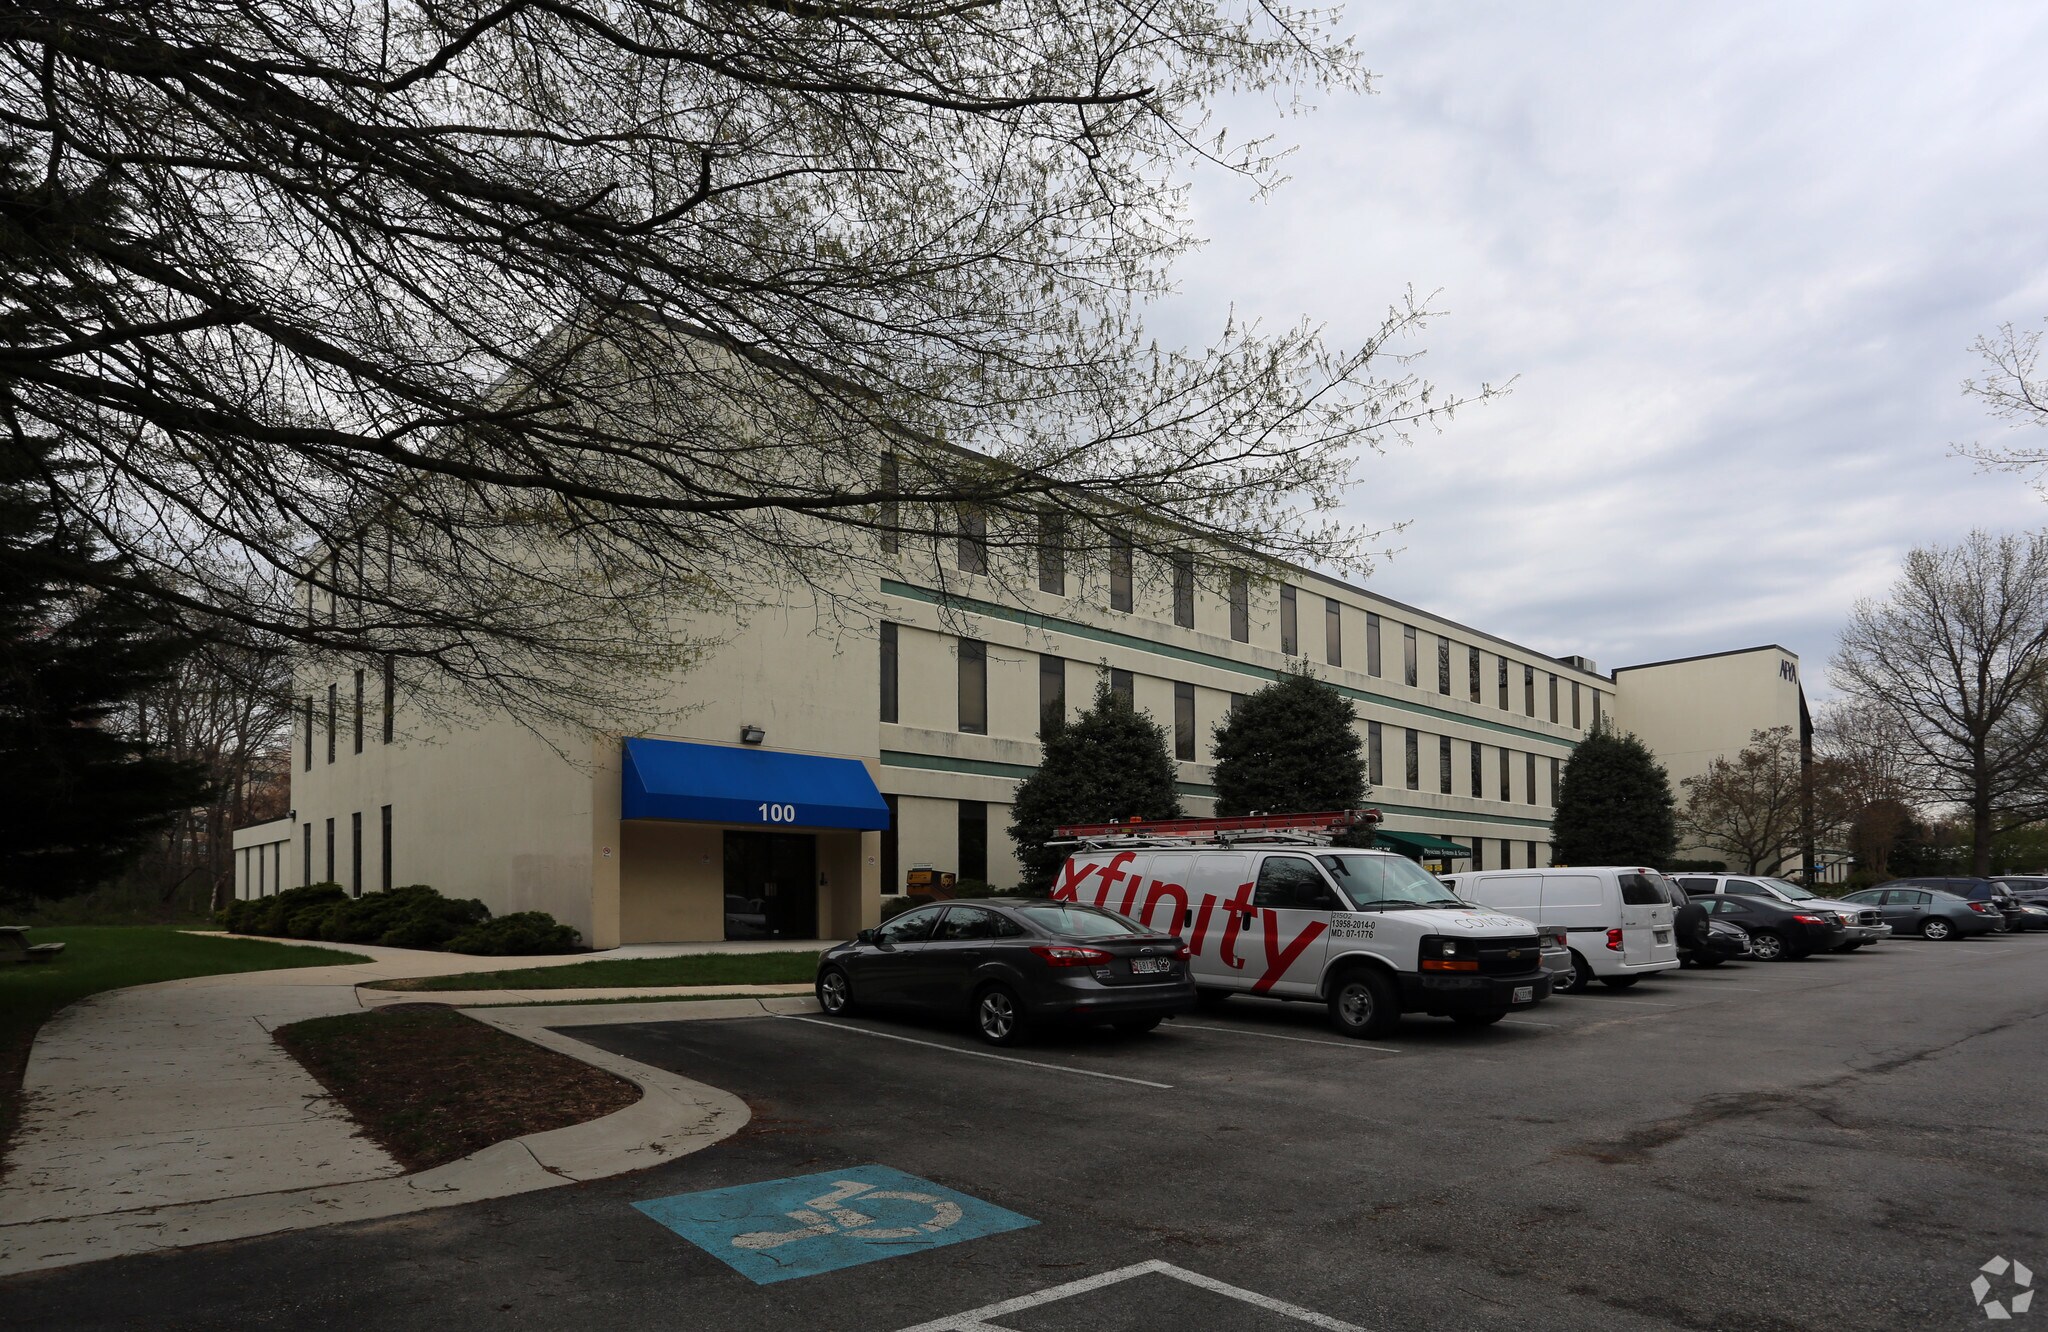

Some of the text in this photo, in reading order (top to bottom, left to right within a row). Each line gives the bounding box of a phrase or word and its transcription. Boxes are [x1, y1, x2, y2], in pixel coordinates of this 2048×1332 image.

[758, 803, 796, 823] 100
[1053, 851, 1328, 992] xfinity
[1332, 920, 1376, 930] 13958-2014-0
[1331, 929, 1374, 939] MD: 07-1776
